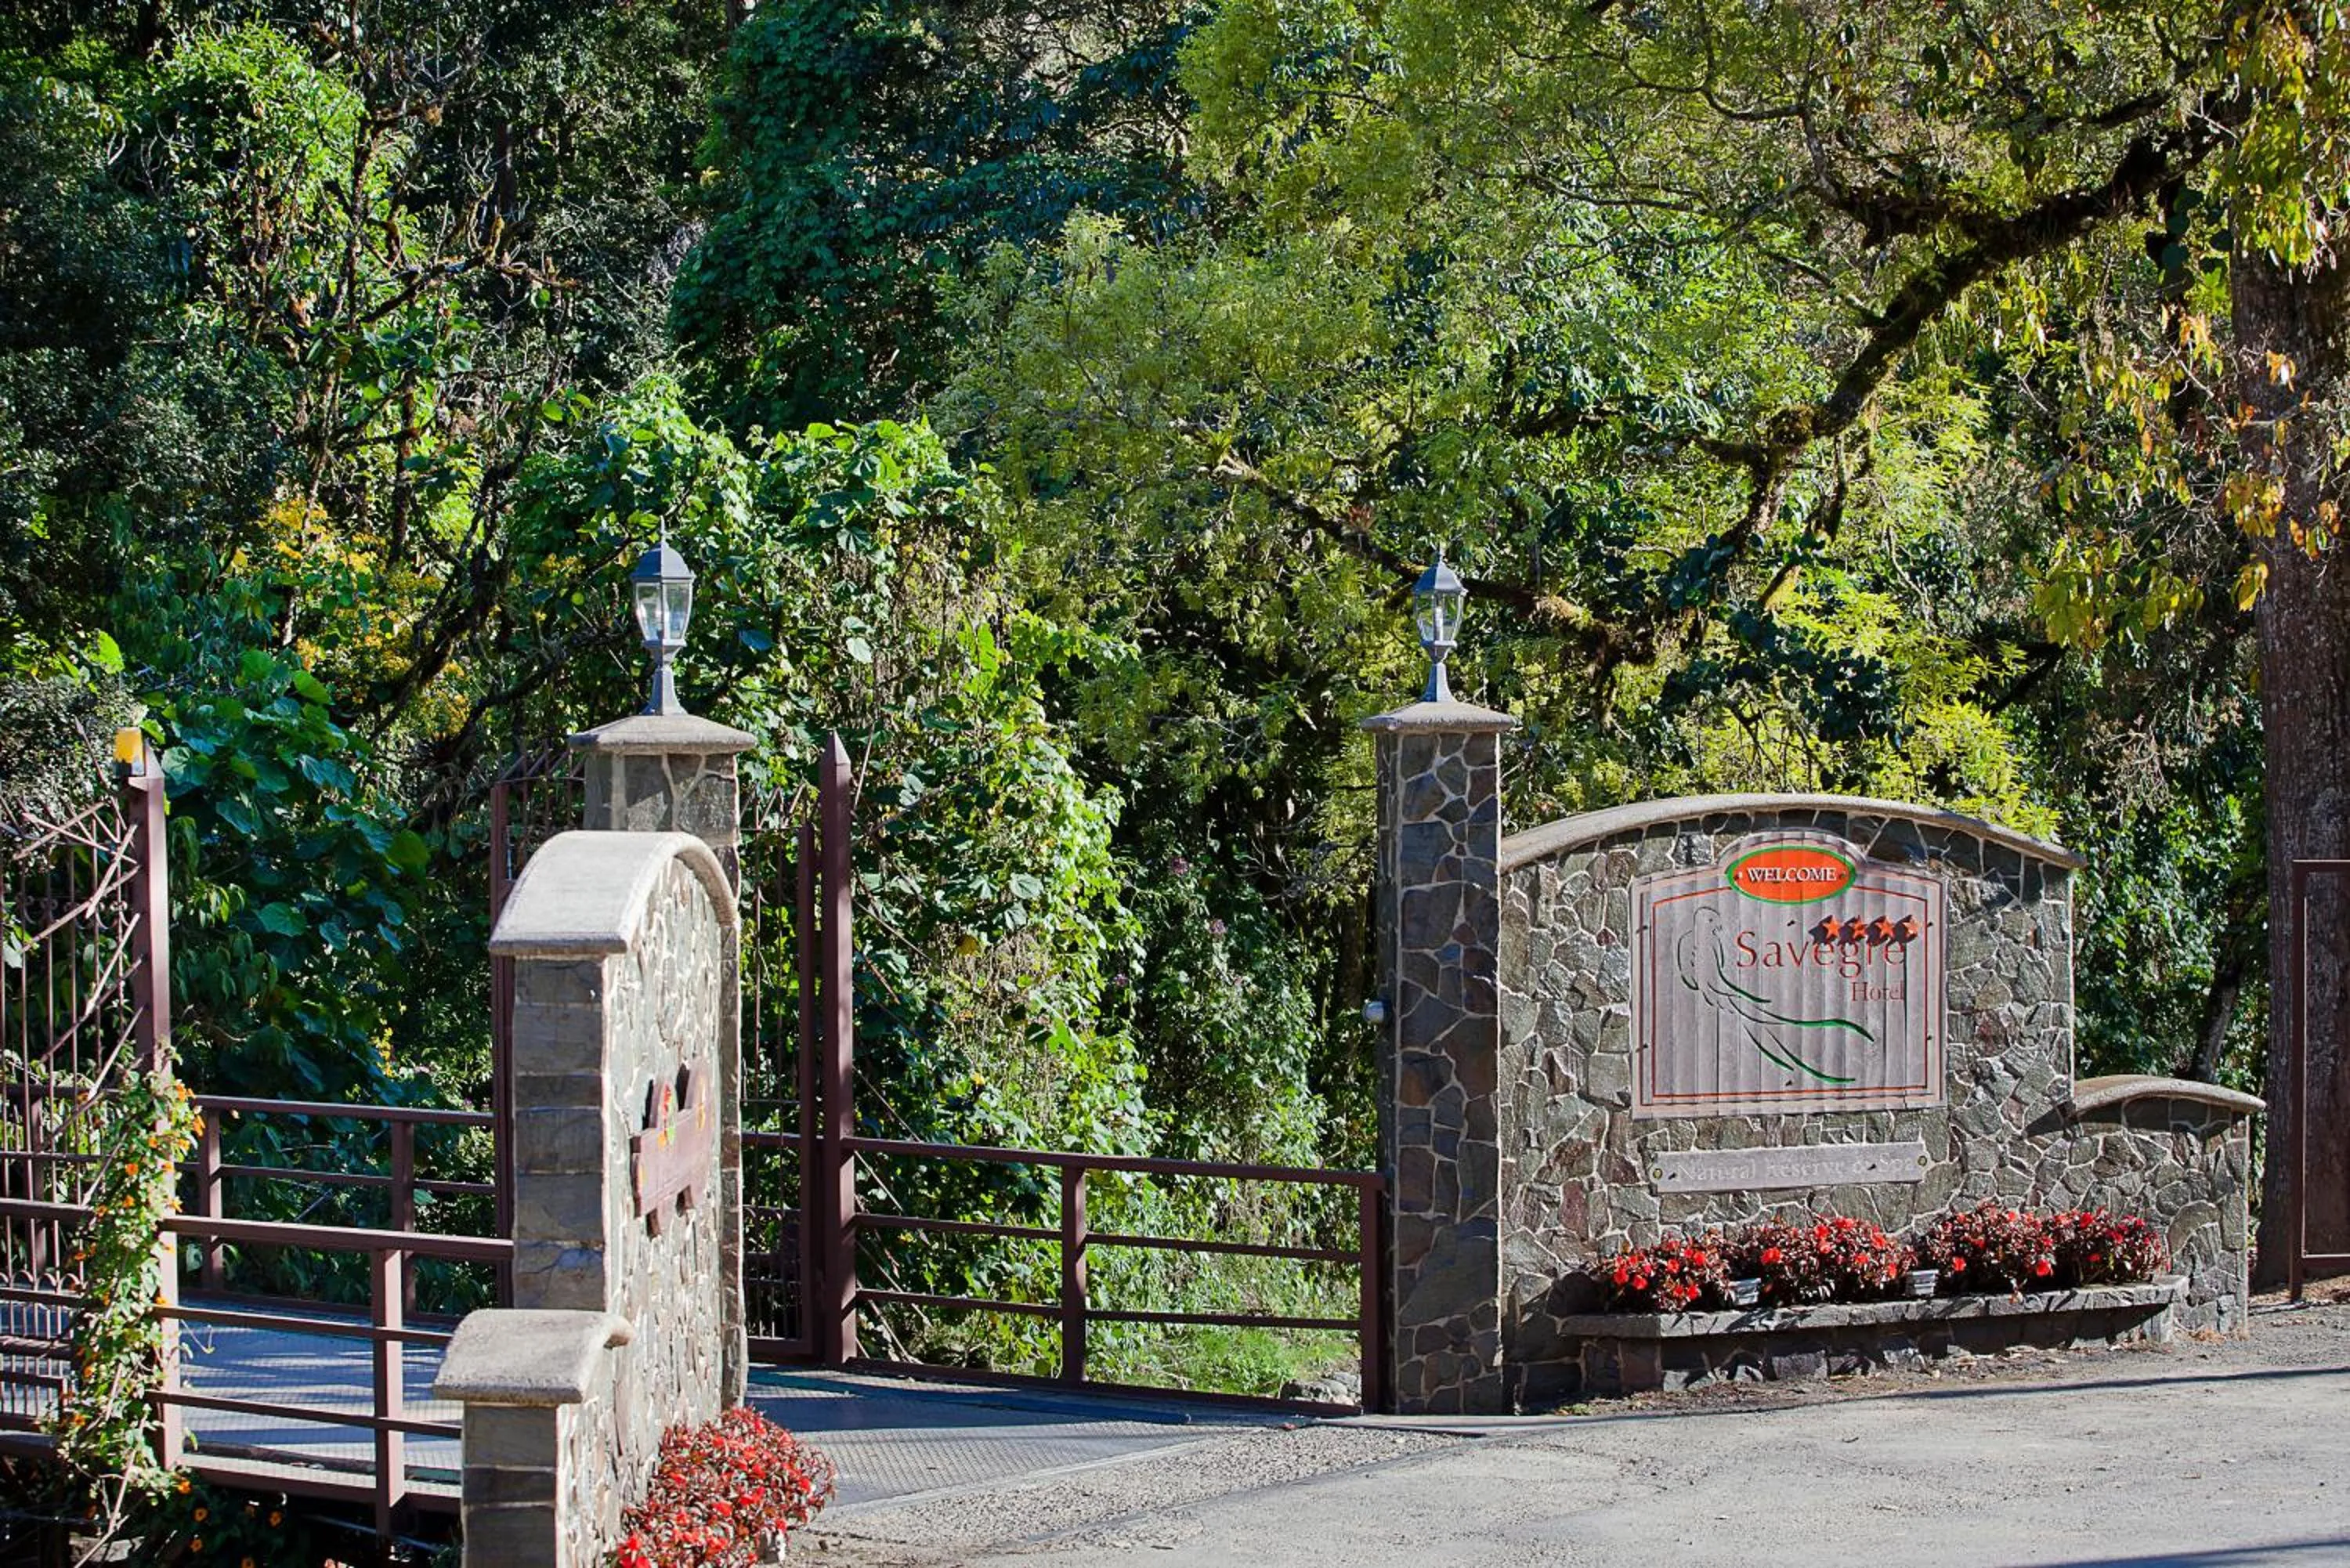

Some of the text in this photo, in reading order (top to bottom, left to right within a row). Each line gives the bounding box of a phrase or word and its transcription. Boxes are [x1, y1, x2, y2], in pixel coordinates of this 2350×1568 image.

[1747, 867, 1837, 882] WELCOME
[1736, 930, 1906, 978] Savegre
[1851, 981, 1905, 1002] Hotel
[1674, 1157, 1755, 1181] Natural
[1766, 1155, 1844, 1178] Reserve
[1879, 1152, 1917, 1176] Spa
